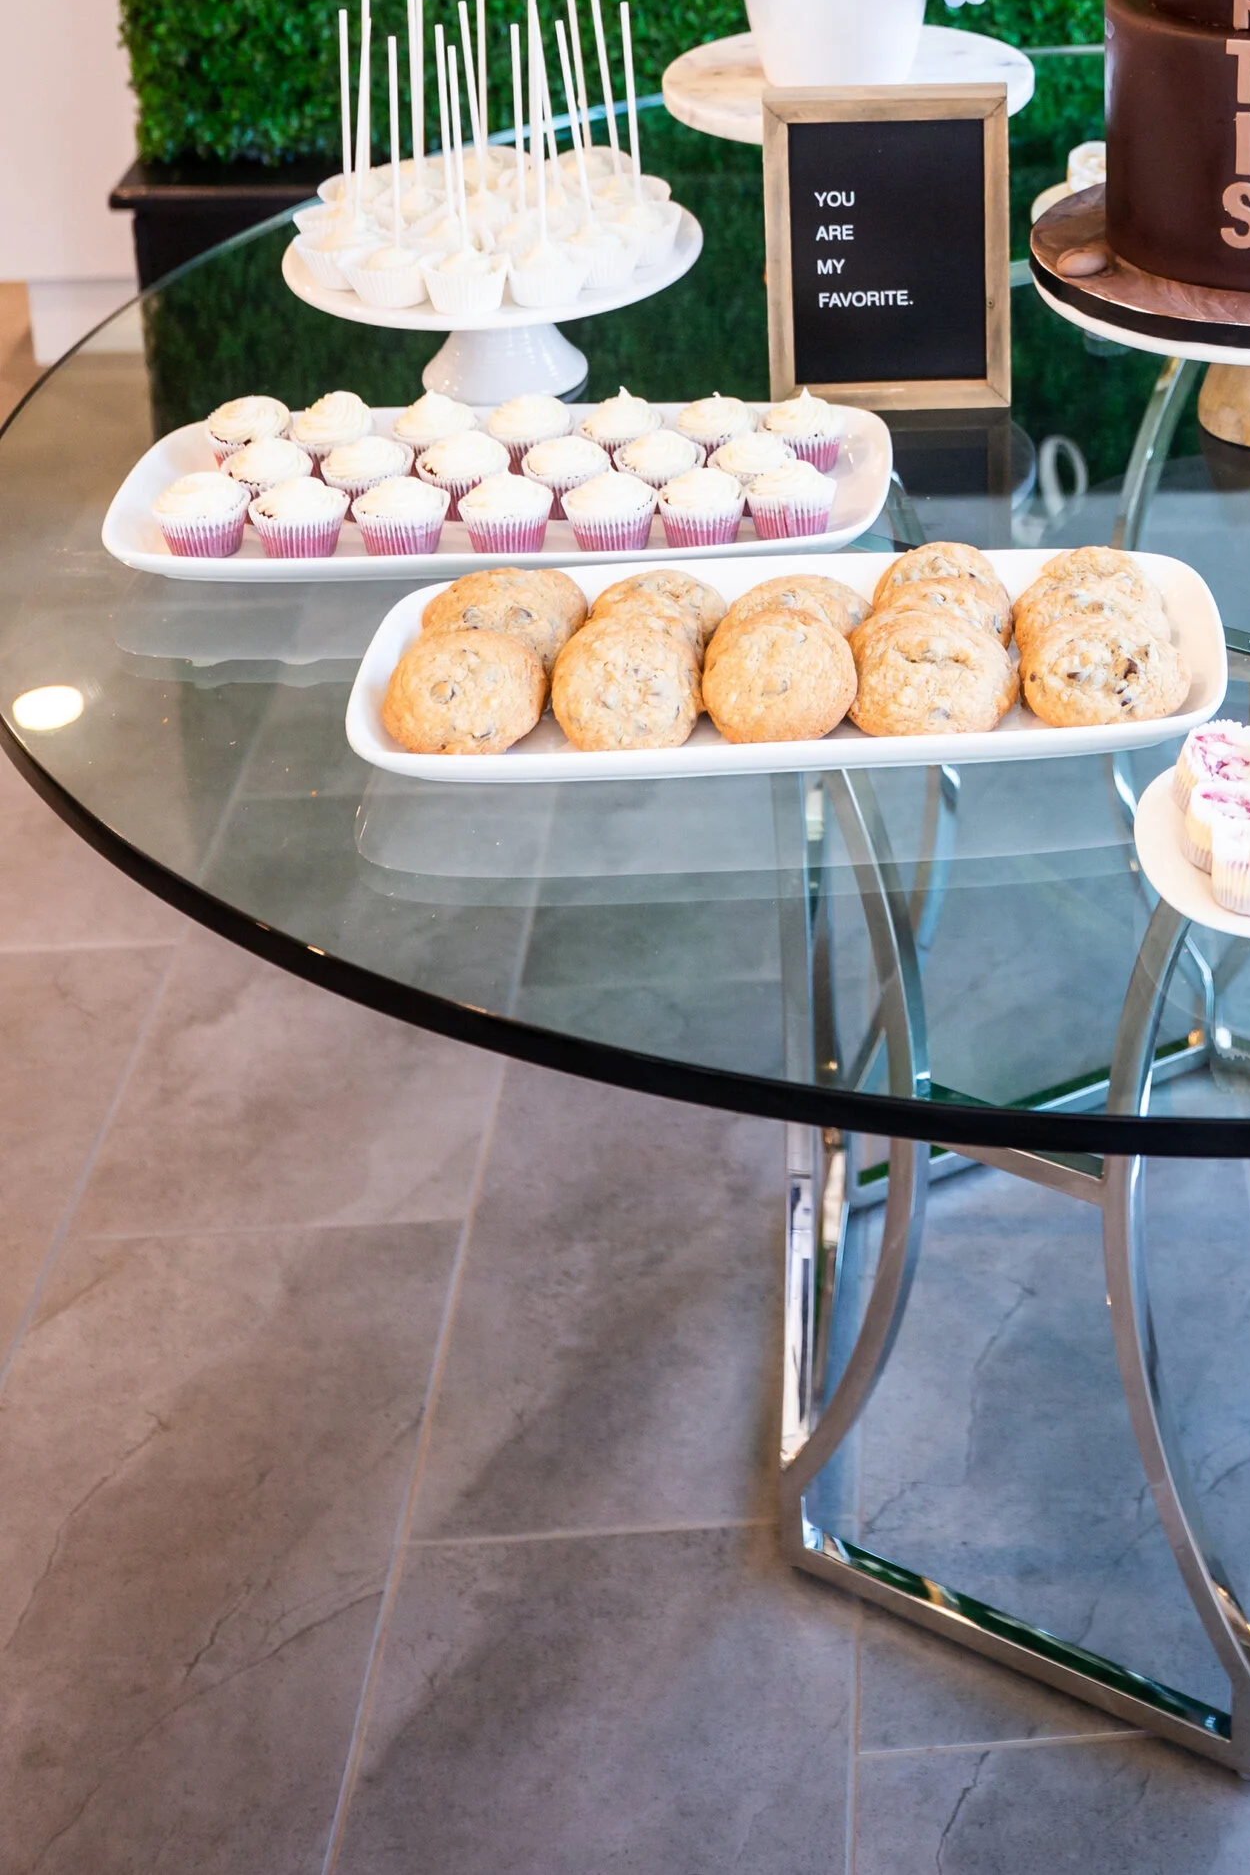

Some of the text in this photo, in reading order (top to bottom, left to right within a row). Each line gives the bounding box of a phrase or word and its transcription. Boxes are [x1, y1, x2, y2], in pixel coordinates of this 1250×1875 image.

[814, 191, 855, 207] YOU
[815, 225, 854, 241] ARE
[817, 259, 845, 275] MY
[818, 290, 914, 308] FAVORITE.
